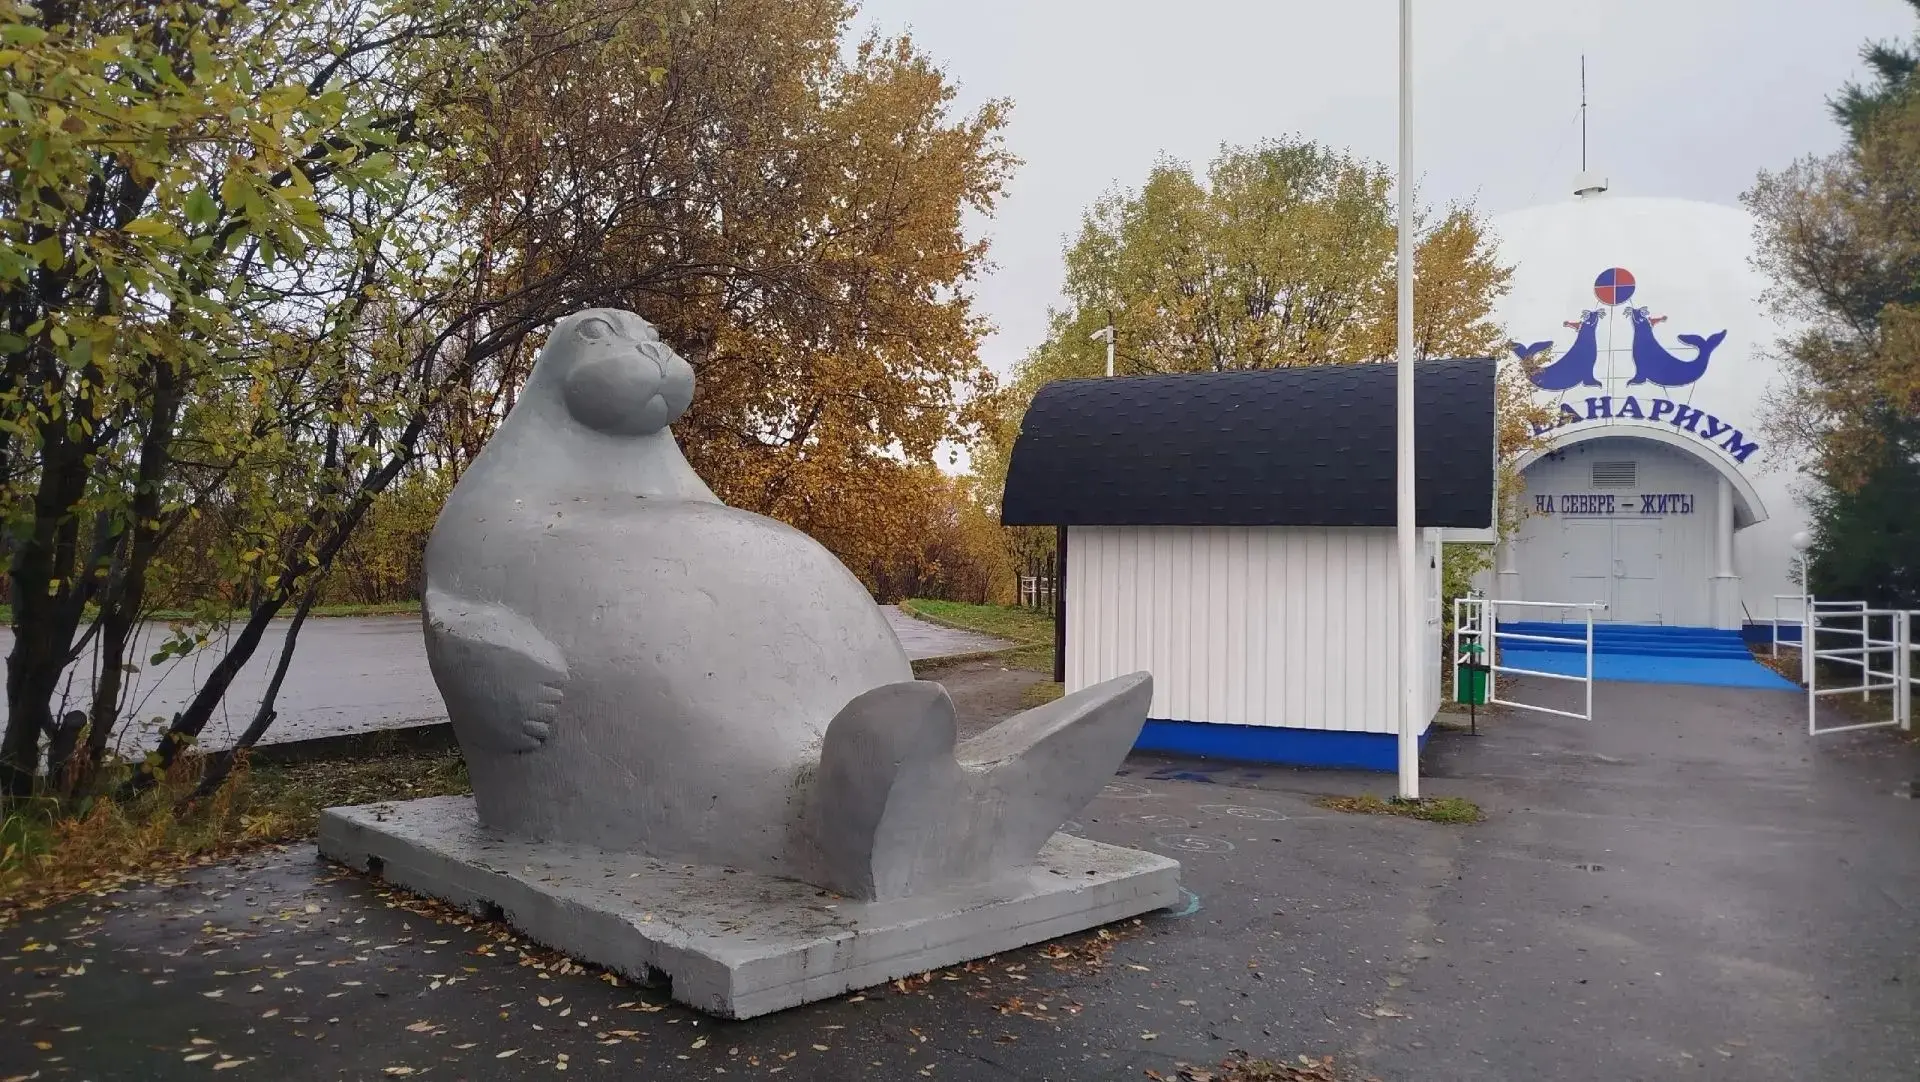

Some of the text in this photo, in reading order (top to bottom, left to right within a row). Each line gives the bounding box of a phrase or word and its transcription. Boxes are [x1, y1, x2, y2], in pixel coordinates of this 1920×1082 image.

[1535, 494, 1555, 513] НА
[1561, 494, 1615, 513] СЕВЕРЕ
[1640, 494, 1694, 514] ЖИТЬ!
